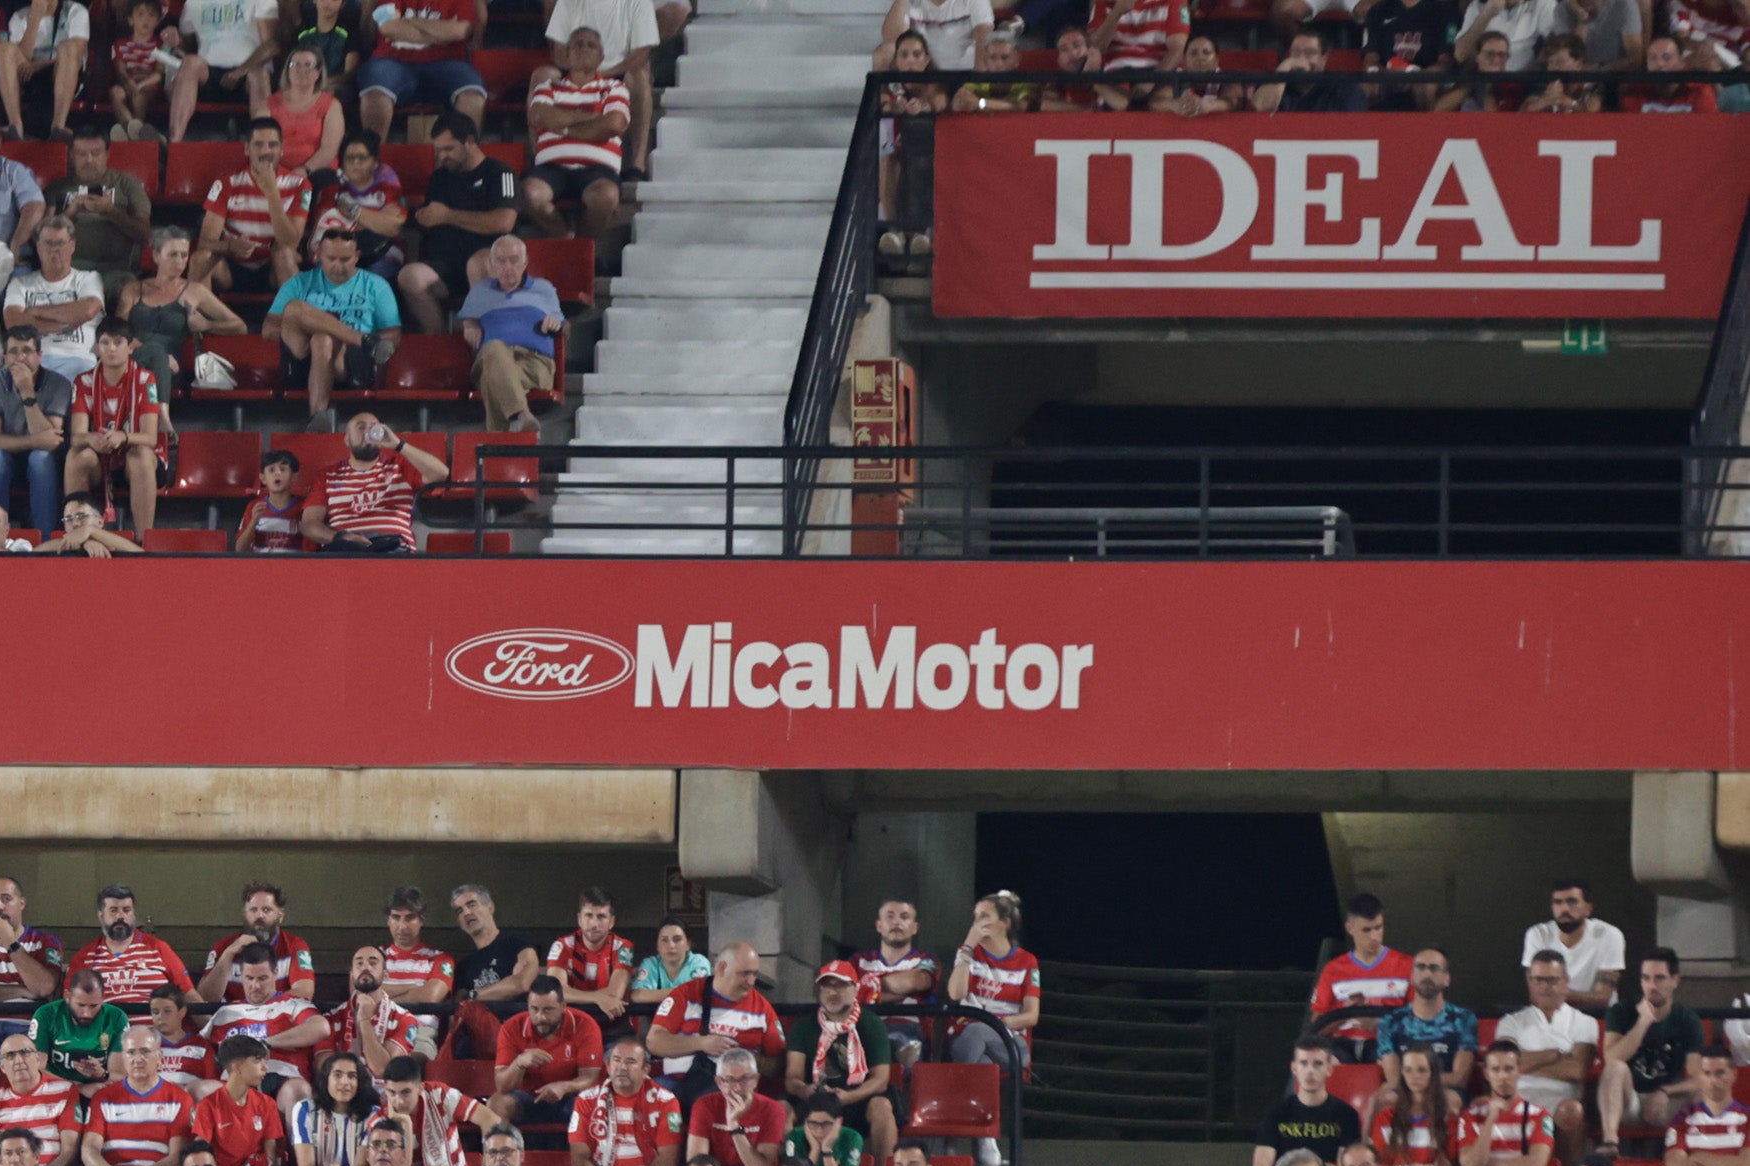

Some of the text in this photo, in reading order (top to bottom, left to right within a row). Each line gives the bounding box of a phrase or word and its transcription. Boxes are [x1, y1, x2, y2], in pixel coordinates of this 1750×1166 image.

[1032, 138, 1662, 262] IDEAL
[482, 621, 1095, 711] Ford MicaMotor
